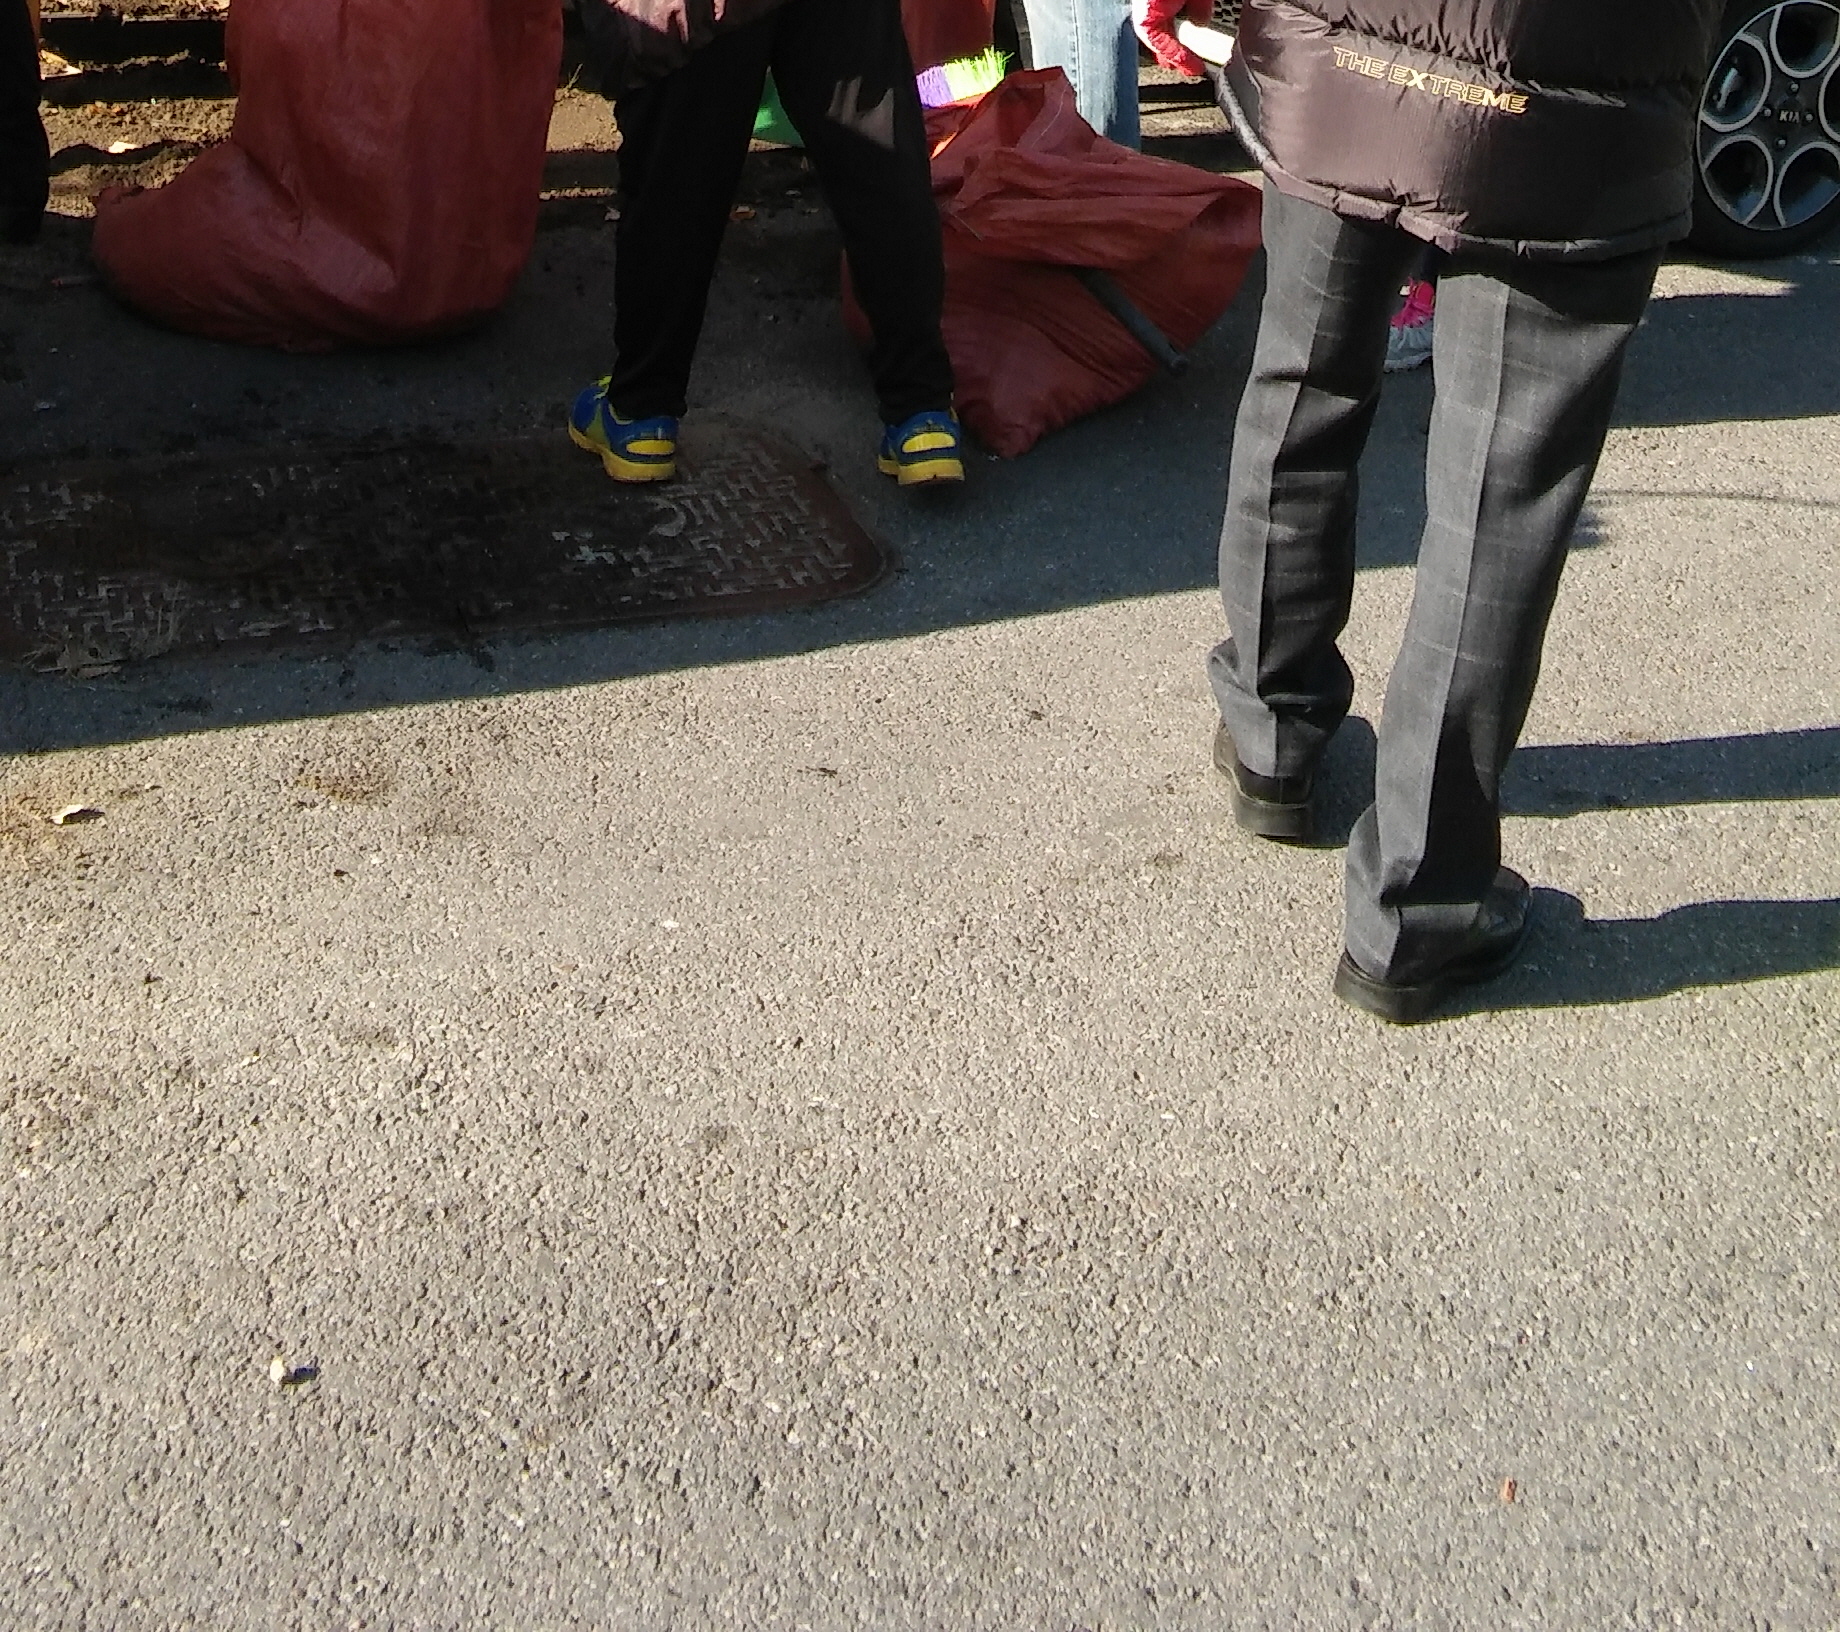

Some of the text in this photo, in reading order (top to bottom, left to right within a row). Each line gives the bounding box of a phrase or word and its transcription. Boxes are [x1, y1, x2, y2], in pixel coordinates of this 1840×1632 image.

[1333, 46, 1529, 114] THE EXTREME
[1779, 110, 1800, 123] KIA
